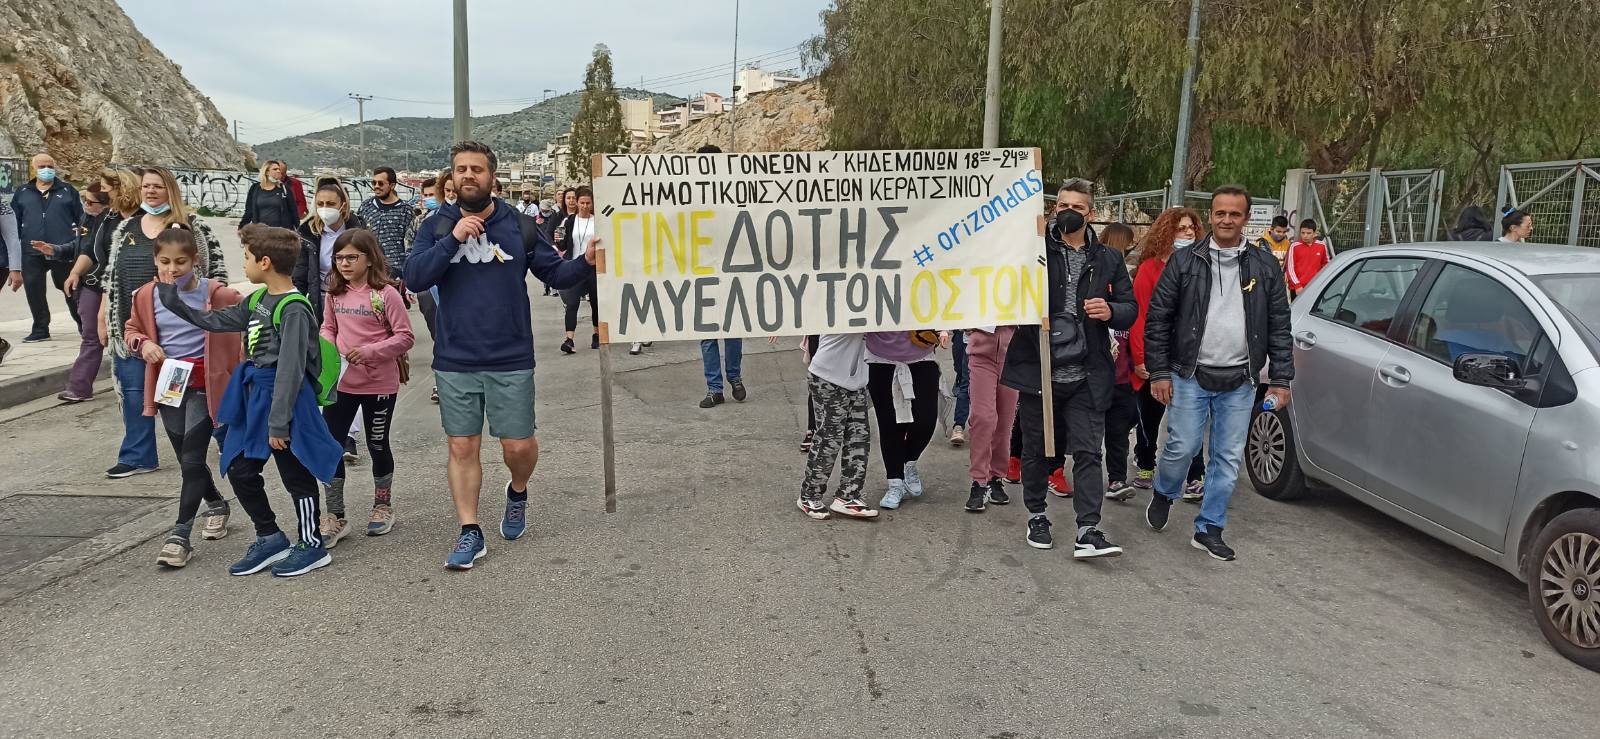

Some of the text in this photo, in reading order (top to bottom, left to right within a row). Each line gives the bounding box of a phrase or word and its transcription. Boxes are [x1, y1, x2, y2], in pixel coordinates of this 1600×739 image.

[606, 155, 716, 176] ΣΥΛΛΟΓΟΙ
[728, 153, 811, 174] ΓΟΝΕΩΝ
[845, 151, 957, 172] ΚΗΔΕΜΟΝΩΝ
[871, 174, 994, 201] ΚΕΡΑΤΣΙΝΙΟΥ
[722, 206, 909, 273] ΔΟΤΗΣ
[619, 273, 810, 335] ΜΥΕΛΟΥ
[816, 272, 901, 328] ΤΩΝ
